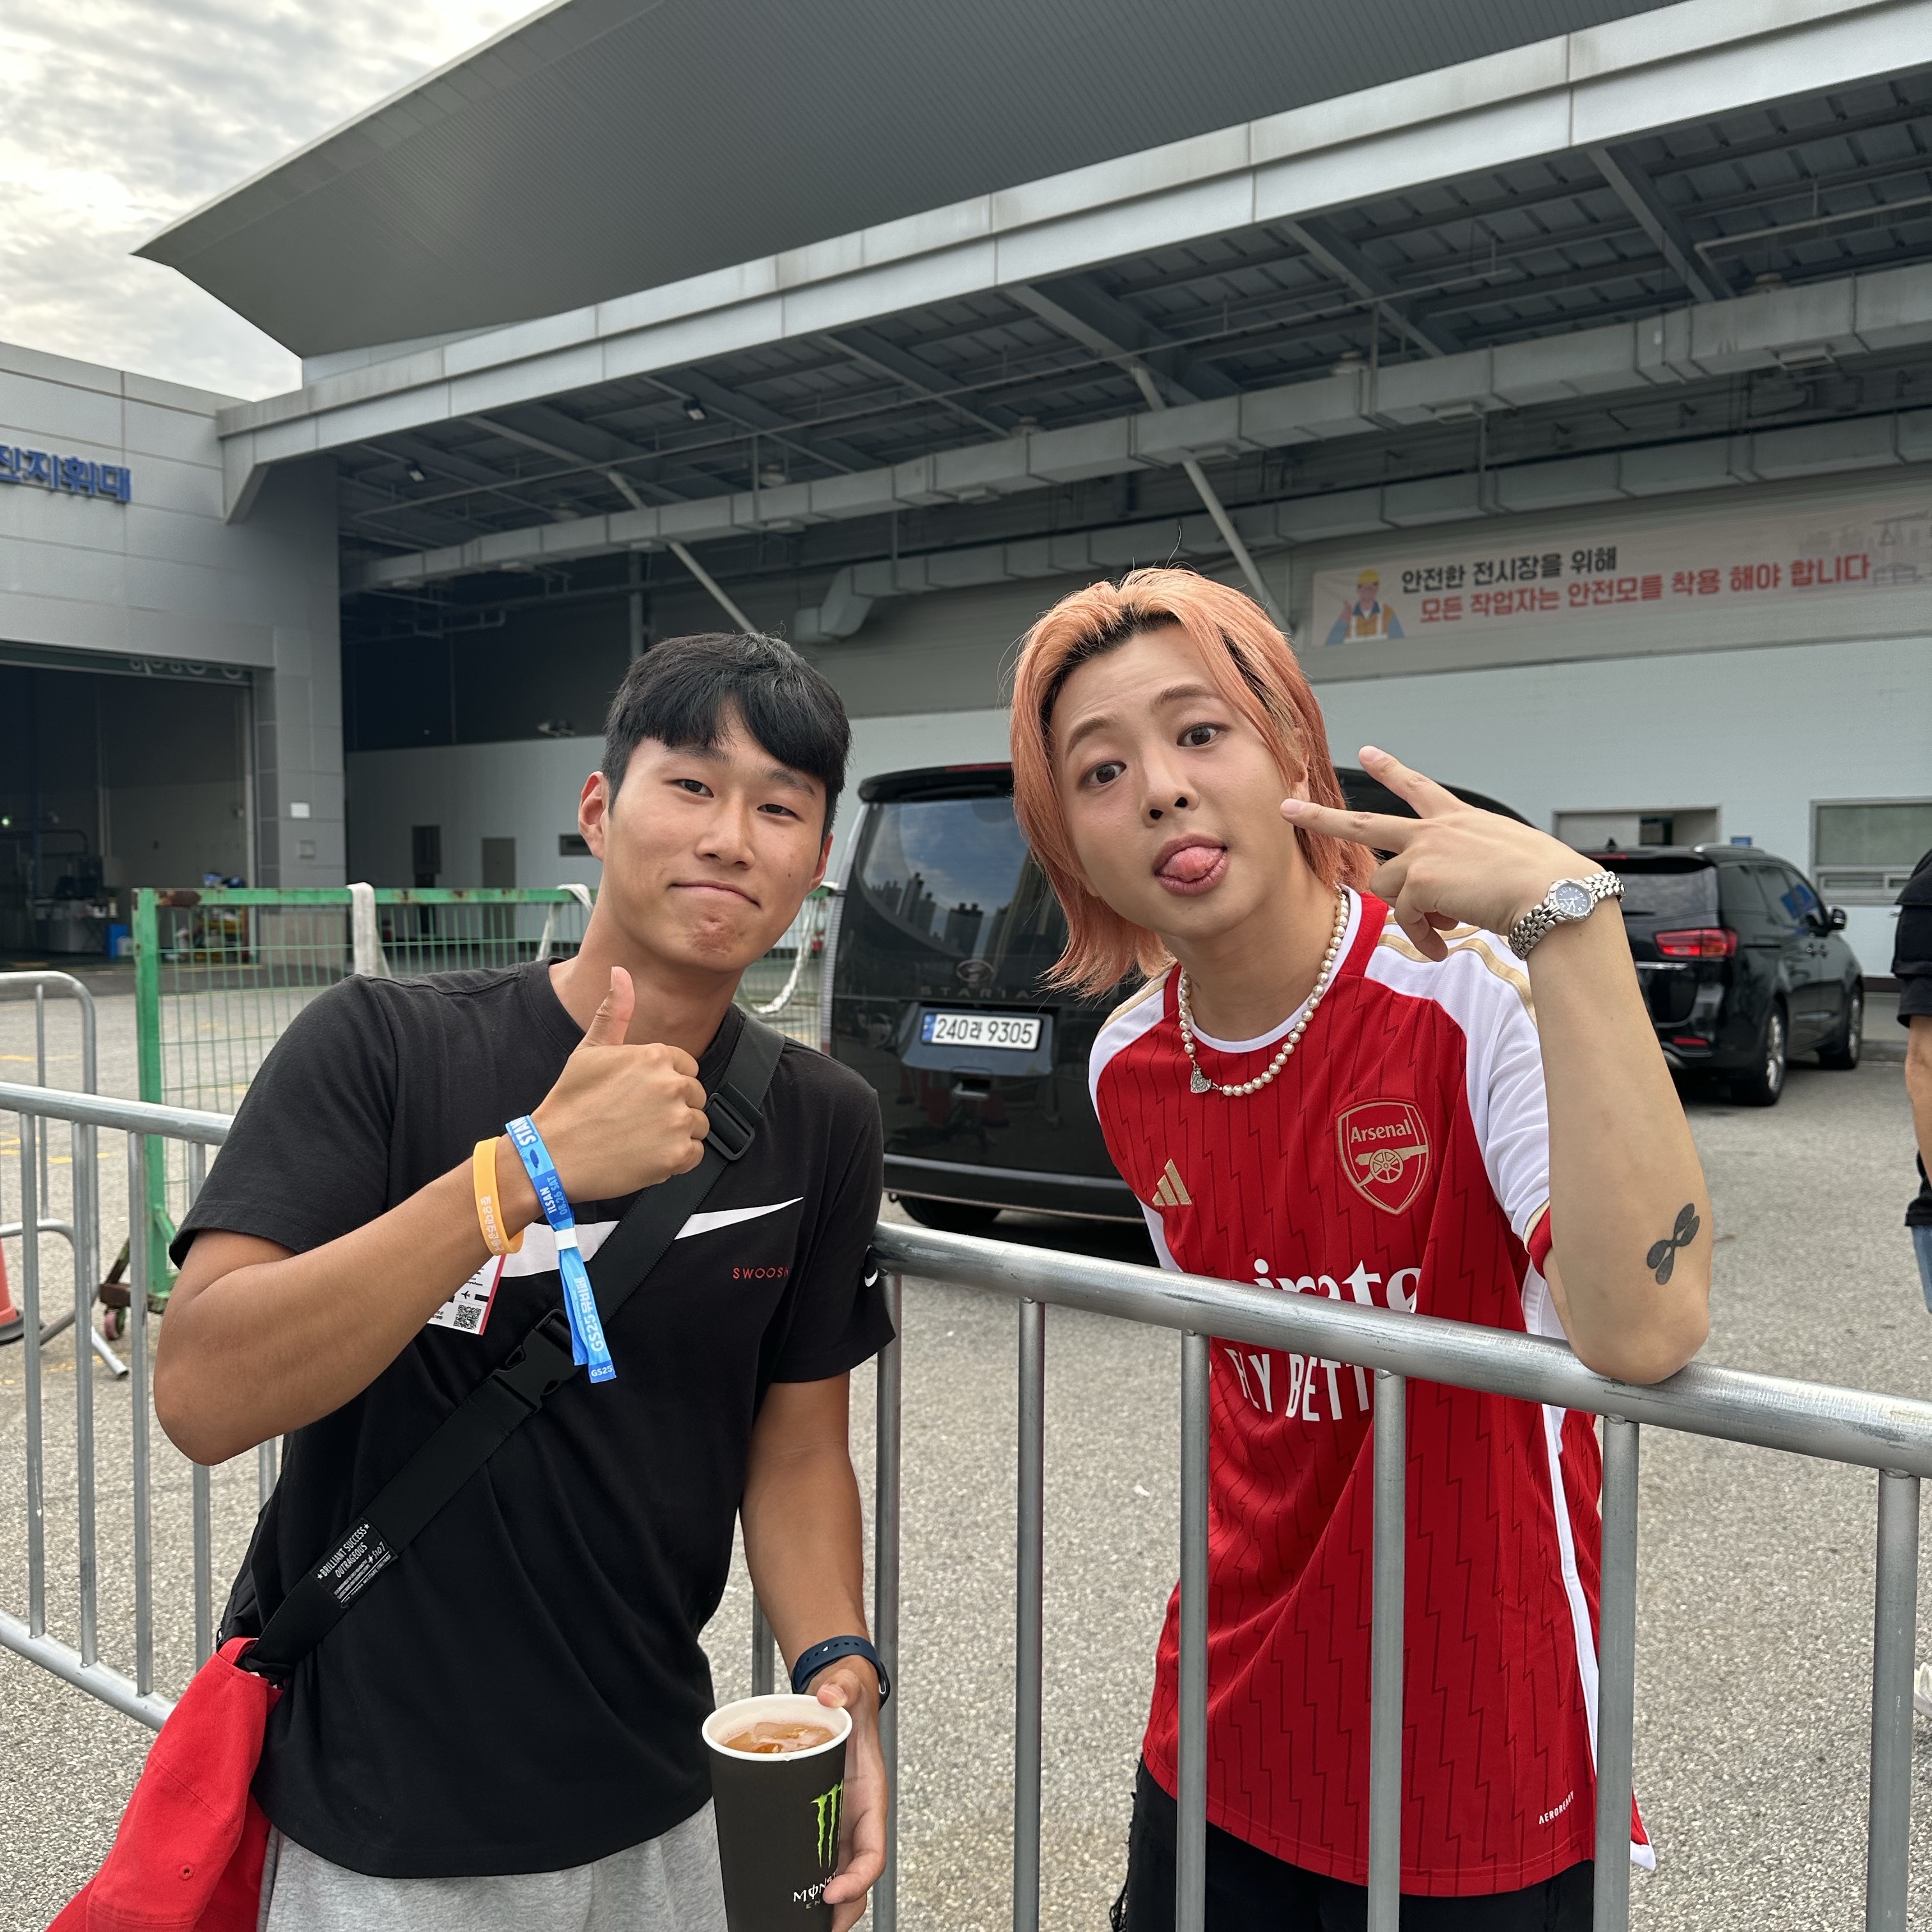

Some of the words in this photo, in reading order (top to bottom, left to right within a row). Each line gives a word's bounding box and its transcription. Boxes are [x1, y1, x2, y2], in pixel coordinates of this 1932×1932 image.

[1402, 564, 1465, 594] 안전한
[1473, 552, 1562, 586] 전시장을
[1571, 546, 1618, 574] 위해
[1420, 595, 1464, 624] 모든
[1470, 586, 1561, 617] 작업자는
[1567, 574, 1663, 608] 안전모를
[1671, 567, 1721, 597] 착용
[1729, 562, 1782, 592] 해야
[1790, 553, 1871, 588] 합니다
[920, 985, 1031, 1000] STARIA
[988, 1020, 1034, 1044] 9305
[1351, 1119, 1412, 1143] Arsenal
[547, 1176, 560, 1192] SAT
[540, 1186, 557, 1215] ILSAN
[554, 1191, 568, 1216] 08.26
[583, 1314, 604, 1352] GS25
[591, 1365, 613, 1377] GS25
[1285, 1353, 1370, 1422] BETT
[319, 1547, 347, 1577] BRILLIANT
[342, 1526, 367, 1552] SUCCESS
[335, 1542, 368, 1578] OUTRAGEOUS
[1538, 1790, 1574, 1825] AEROREADY
